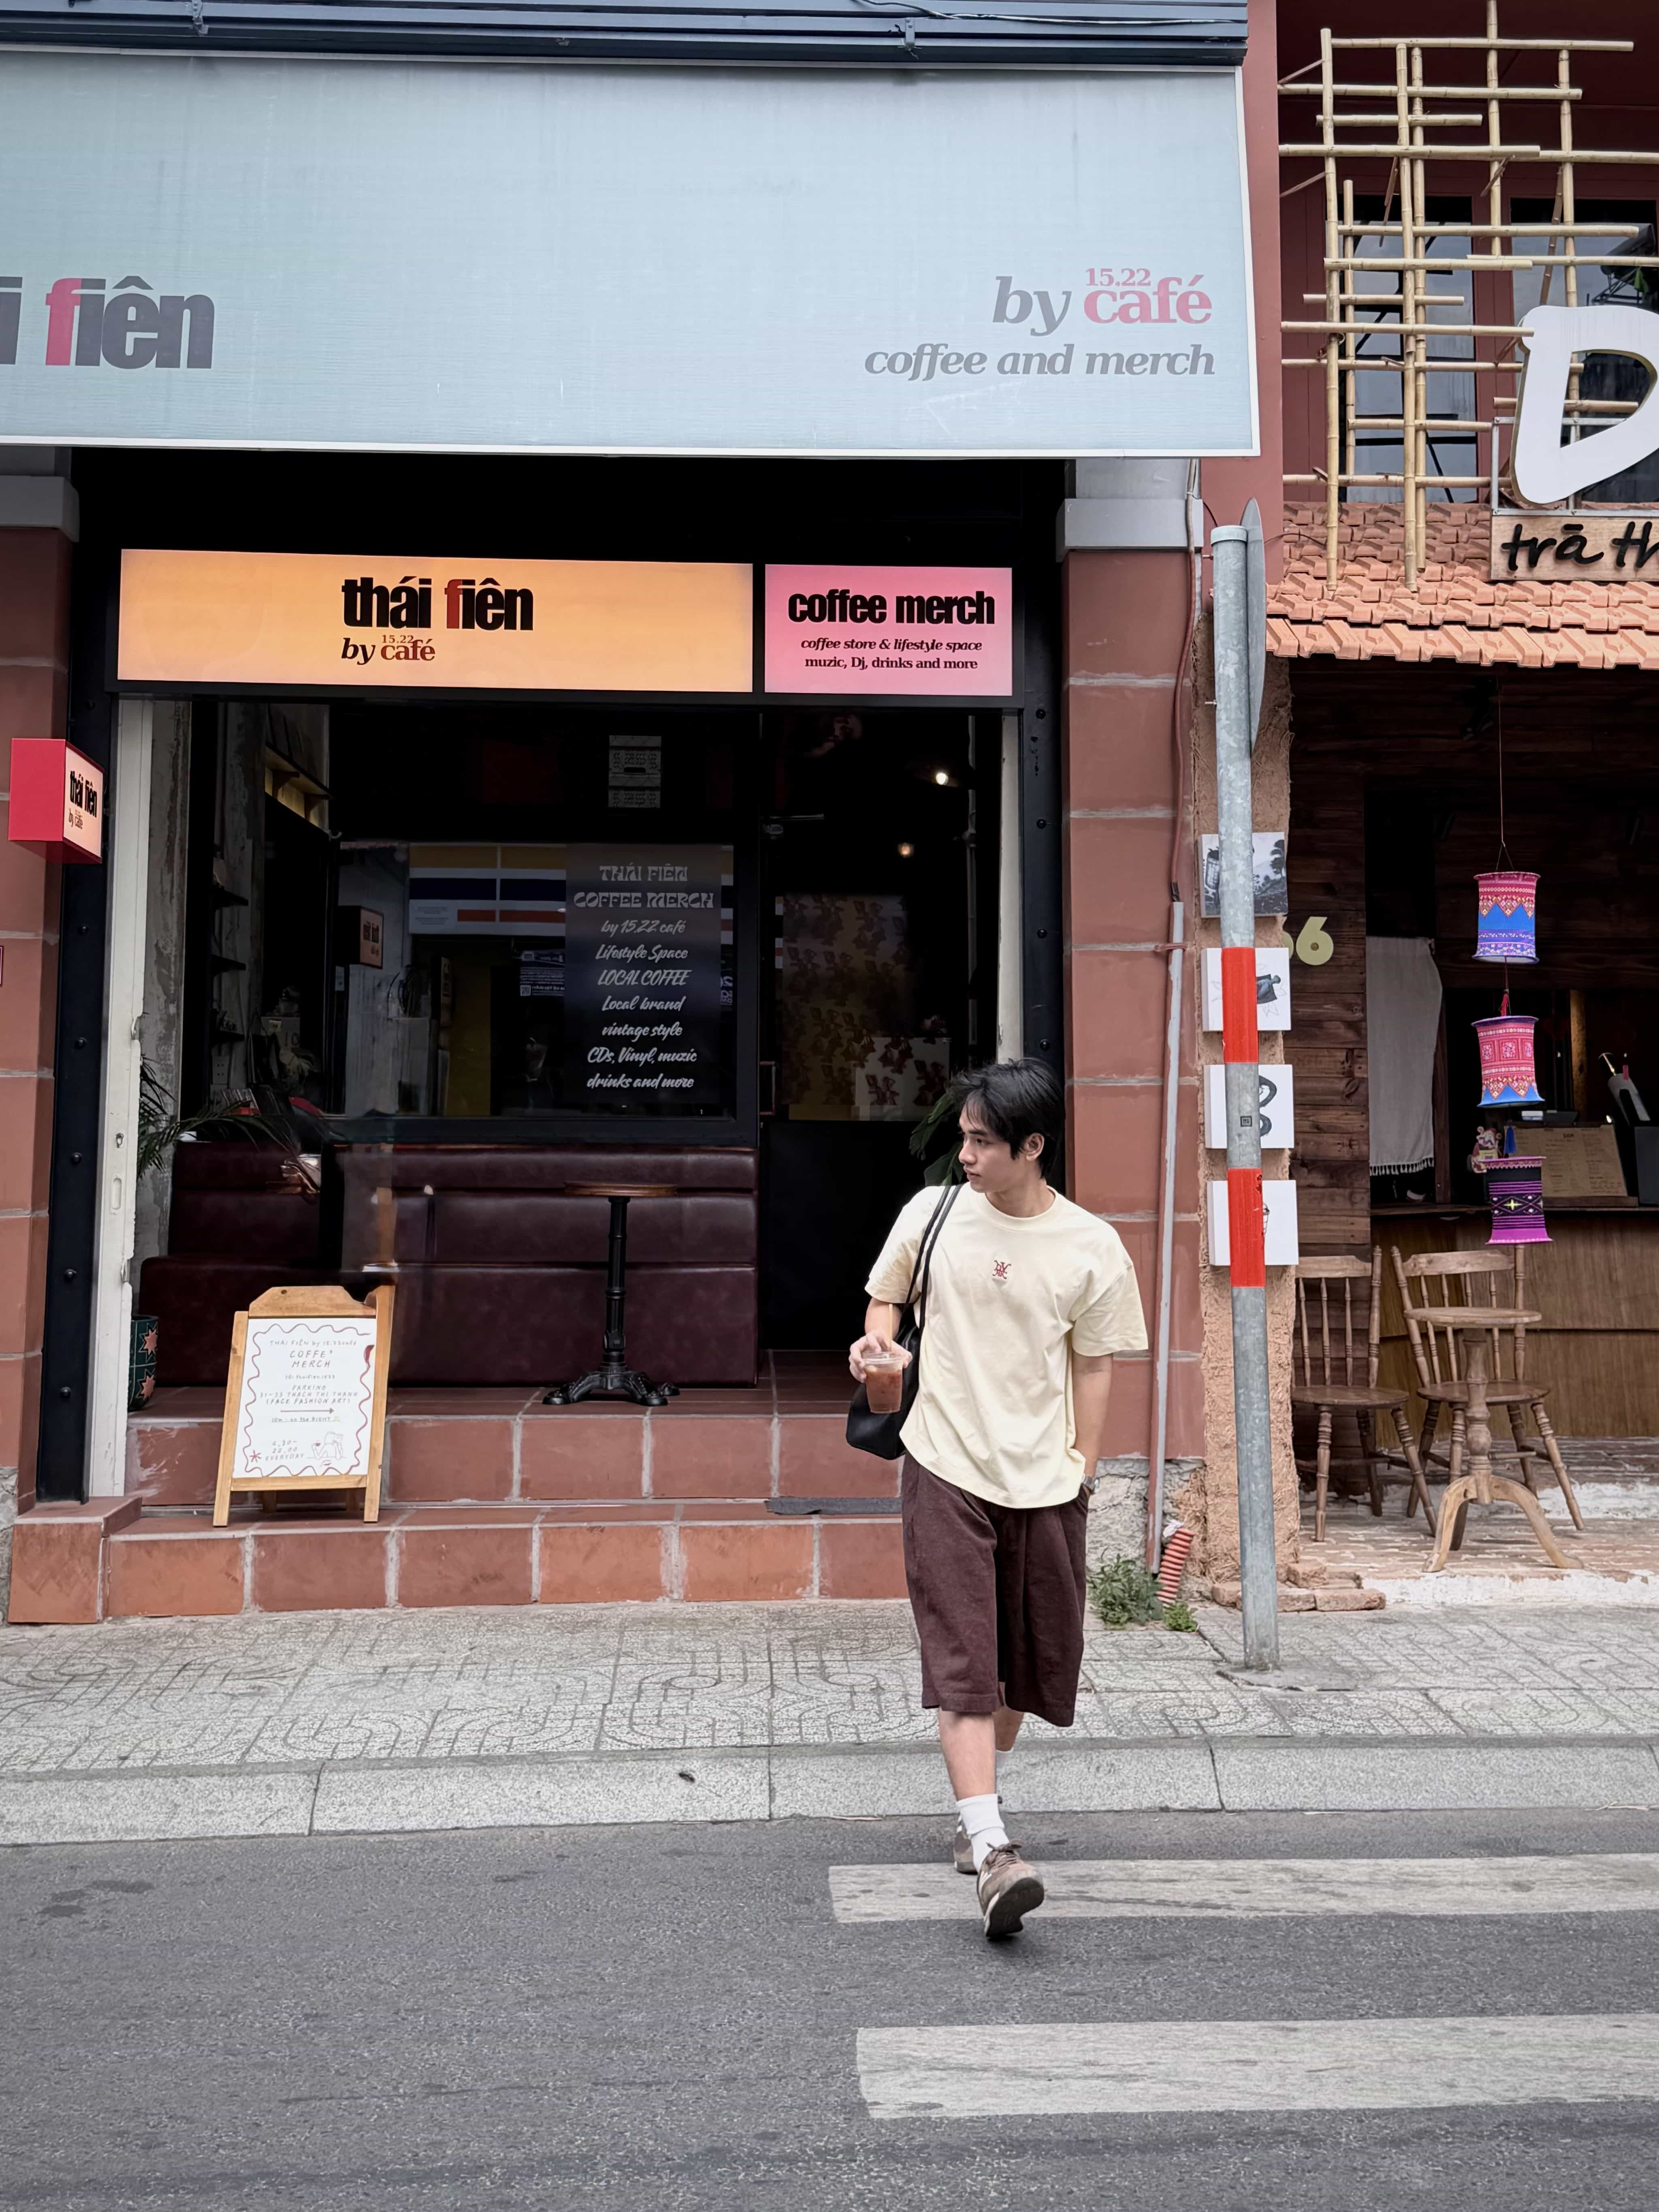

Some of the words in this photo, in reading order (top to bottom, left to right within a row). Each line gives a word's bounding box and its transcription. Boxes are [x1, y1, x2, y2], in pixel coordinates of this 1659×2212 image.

[1085, 268, 1151, 287] 15.22
[993, 276, 1071, 337] by
[1084, 274, 1212, 324] café
[45, 275, 215, 369] fiên
[865, 343, 987, 381] coffee
[997, 344, 1075, 375] and
[1085, 344, 1215, 375] merch
[341, 575, 432, 629] thái
[445, 578, 534, 631] fiên
[788, 589, 887, 623] coffee
[896, 591, 995, 624] merch
[382, 635, 414, 644] 15.22
[801, 637, 841, 650] coffee
[844, 639, 876, 650] store
[879, 639, 891, 650] &
[893, 638, 943, 653] lifestyle
[945, 641, 982, 652] space
[341, 637, 375, 665] by
[381, 639, 436, 661] café
[805, 657, 847, 669] muzic,
[851, 657, 868, 670] Dj,
[872, 657, 913, 669] drinks
[916, 658, 940, 669] and
[943, 660, 978, 669] more
[70, 771, 83, 808] thái
[599, 862, 642, 881] THÁI
[647, 863, 688, 882] FIÊN
[574, 892, 642, 908] COFFEE
[646, 892, 714, 908] MERCH
[601, 920, 618, 938] by
[620, 919, 659, 934] 15.22
[659, 920, 687, 936] café
[595, 944, 647, 963] Lifestyle
[648, 944, 689, 964] Space
[597, 970, 641, 986] LOCAL
[641, 969, 692, 987] COFFEE
[601, 995, 640, 1012] Local
[640, 995, 687, 1012] brand
[601, 1022, 649, 1042] vintage
[650, 1021, 683, 1041] style
[587, 1046, 616, 1064] CDs,
[618, 1047, 657, 1067] Vinyl,
[657, 1048, 697, 1063] muzic
[586, 1073, 632, 1089] drinks
[632, 1073, 664, 1089] and
[661, 1076, 695, 1089] more
[291, 1360, 331, 1368] MERCH
[265, 1453, 304, 1461] EVERYDAY
